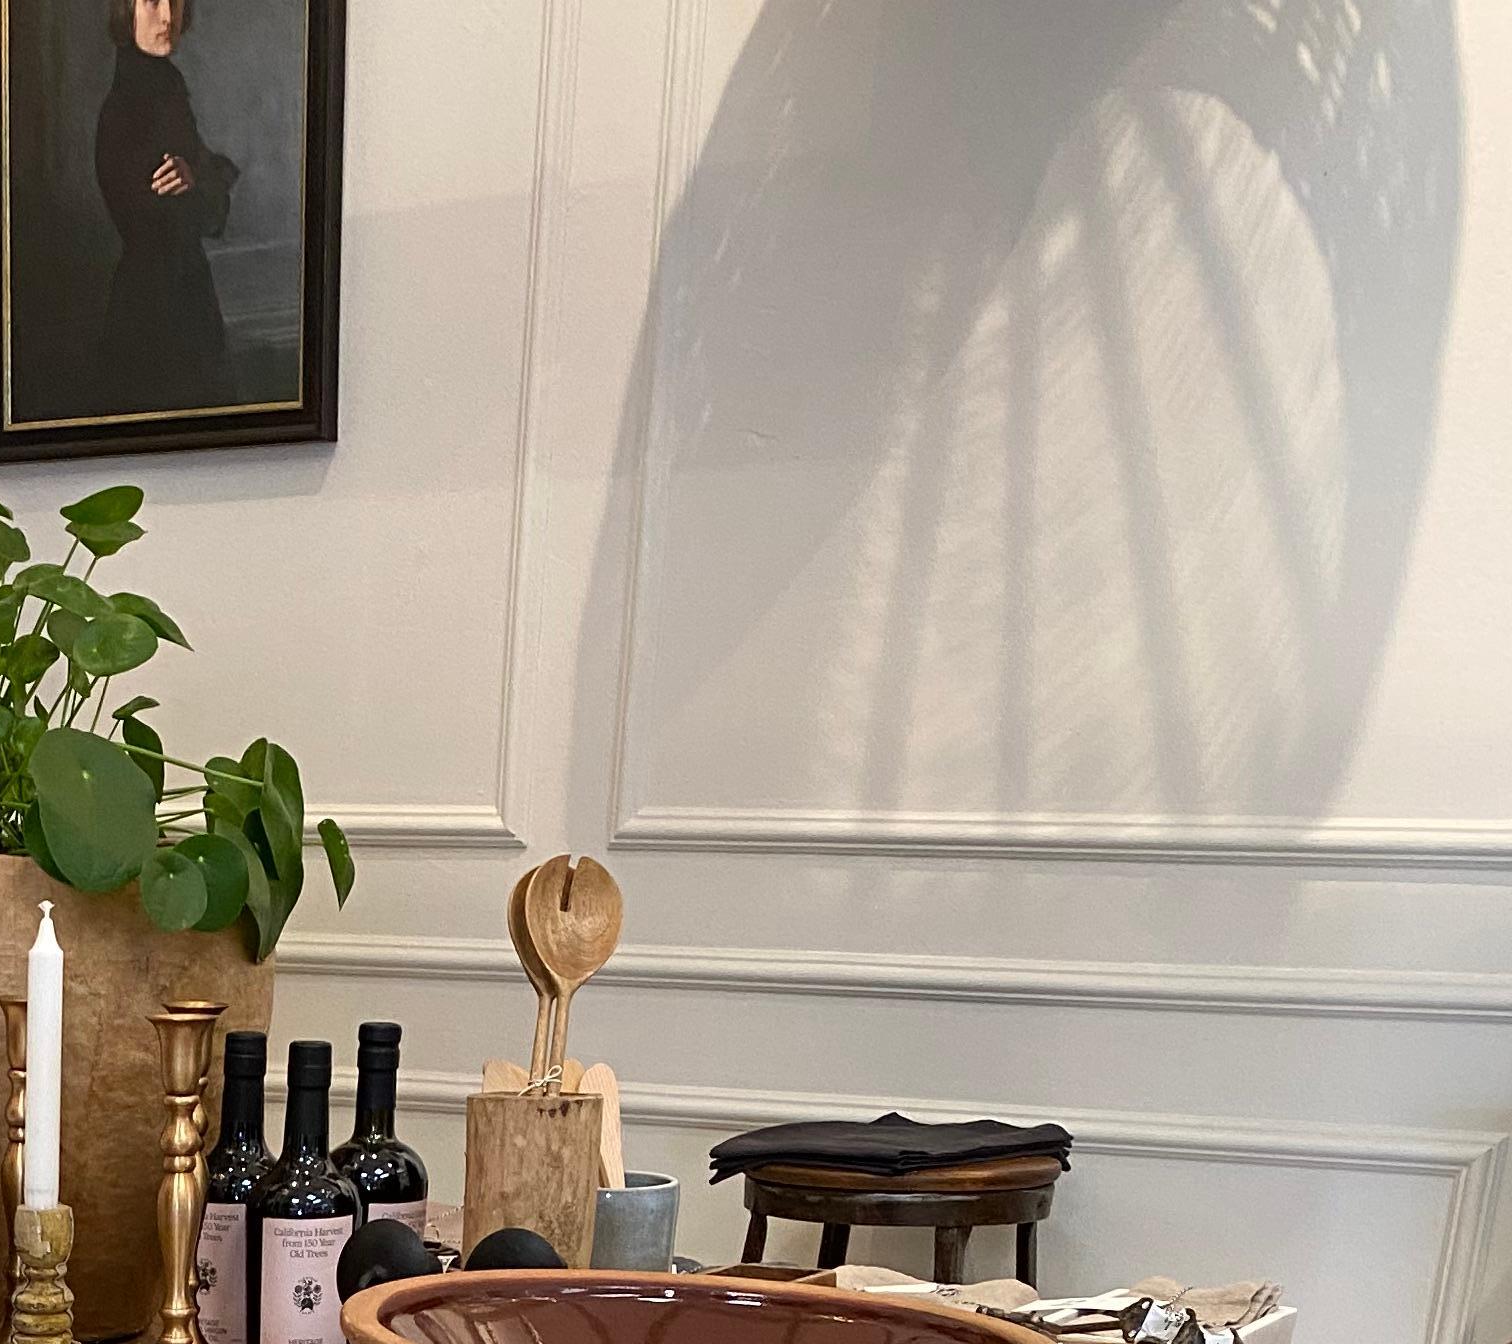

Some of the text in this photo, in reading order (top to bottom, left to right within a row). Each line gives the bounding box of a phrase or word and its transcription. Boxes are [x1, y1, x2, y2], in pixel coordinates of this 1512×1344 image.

[273, 1227, 344, 1238] California Harvest
[282, 1238, 336, 1248] from 150 Year
[289, 1249, 329, 1258] Old Trees
